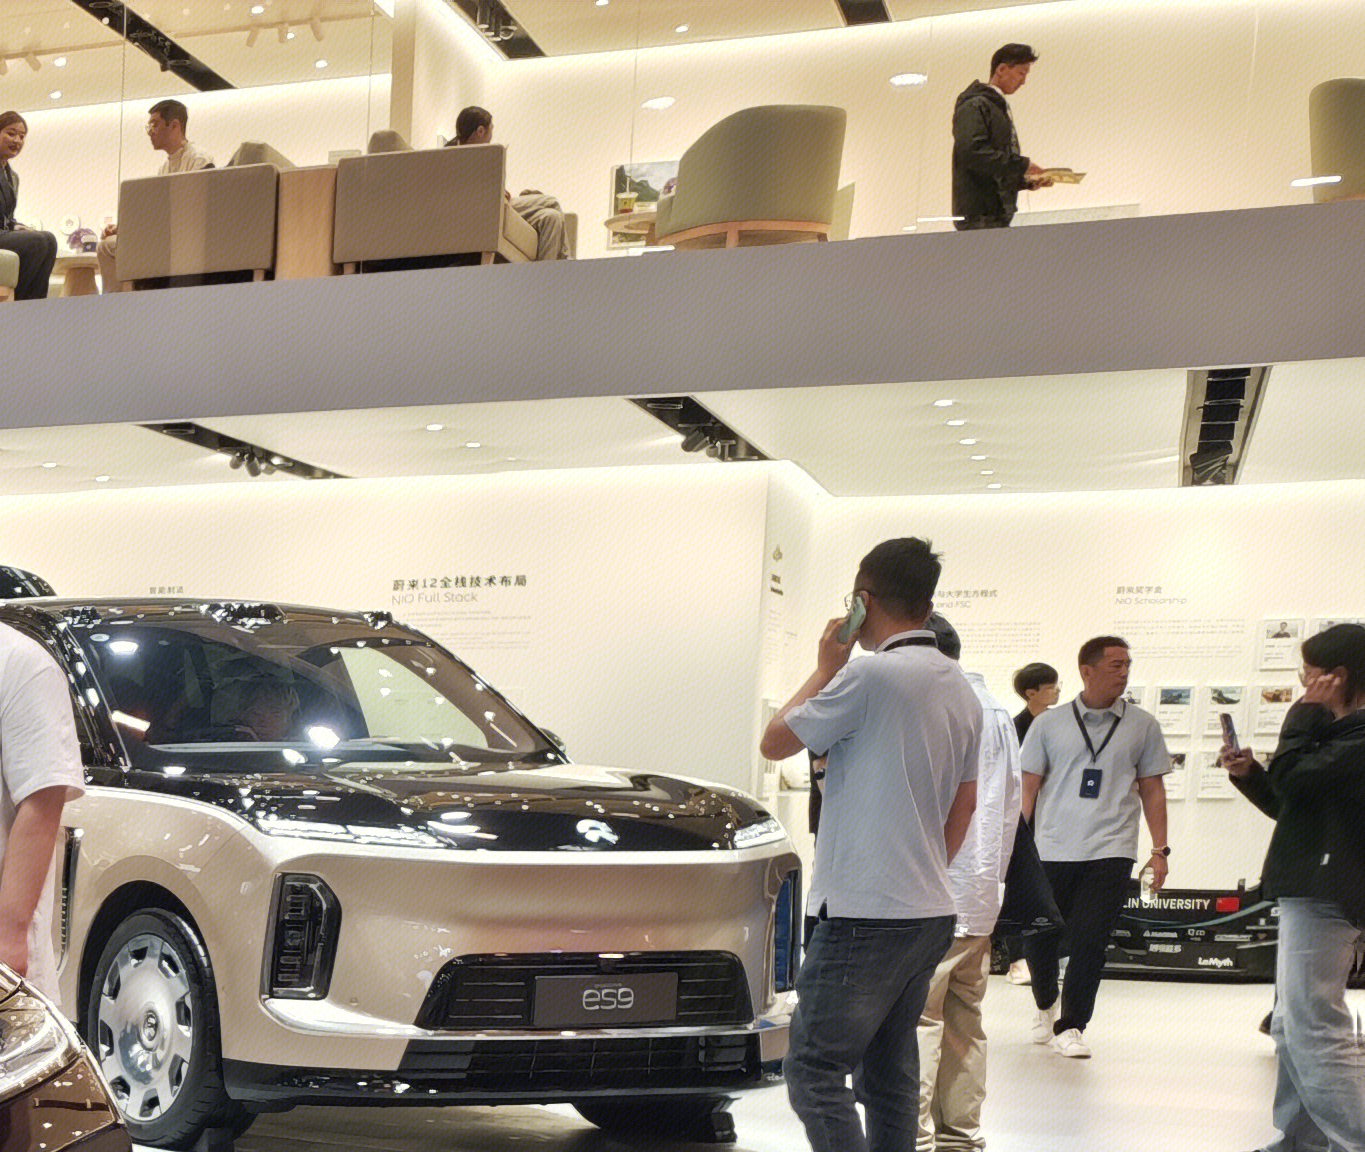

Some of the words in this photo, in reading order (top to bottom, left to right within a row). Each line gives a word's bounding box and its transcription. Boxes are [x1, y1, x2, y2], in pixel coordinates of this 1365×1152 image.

[391, 593, 415, 606] NIO
[418, 591, 441, 604] Full
[444, 590, 478, 603] Stack
[1142, 898, 1210, 910] UNIVERSITY
